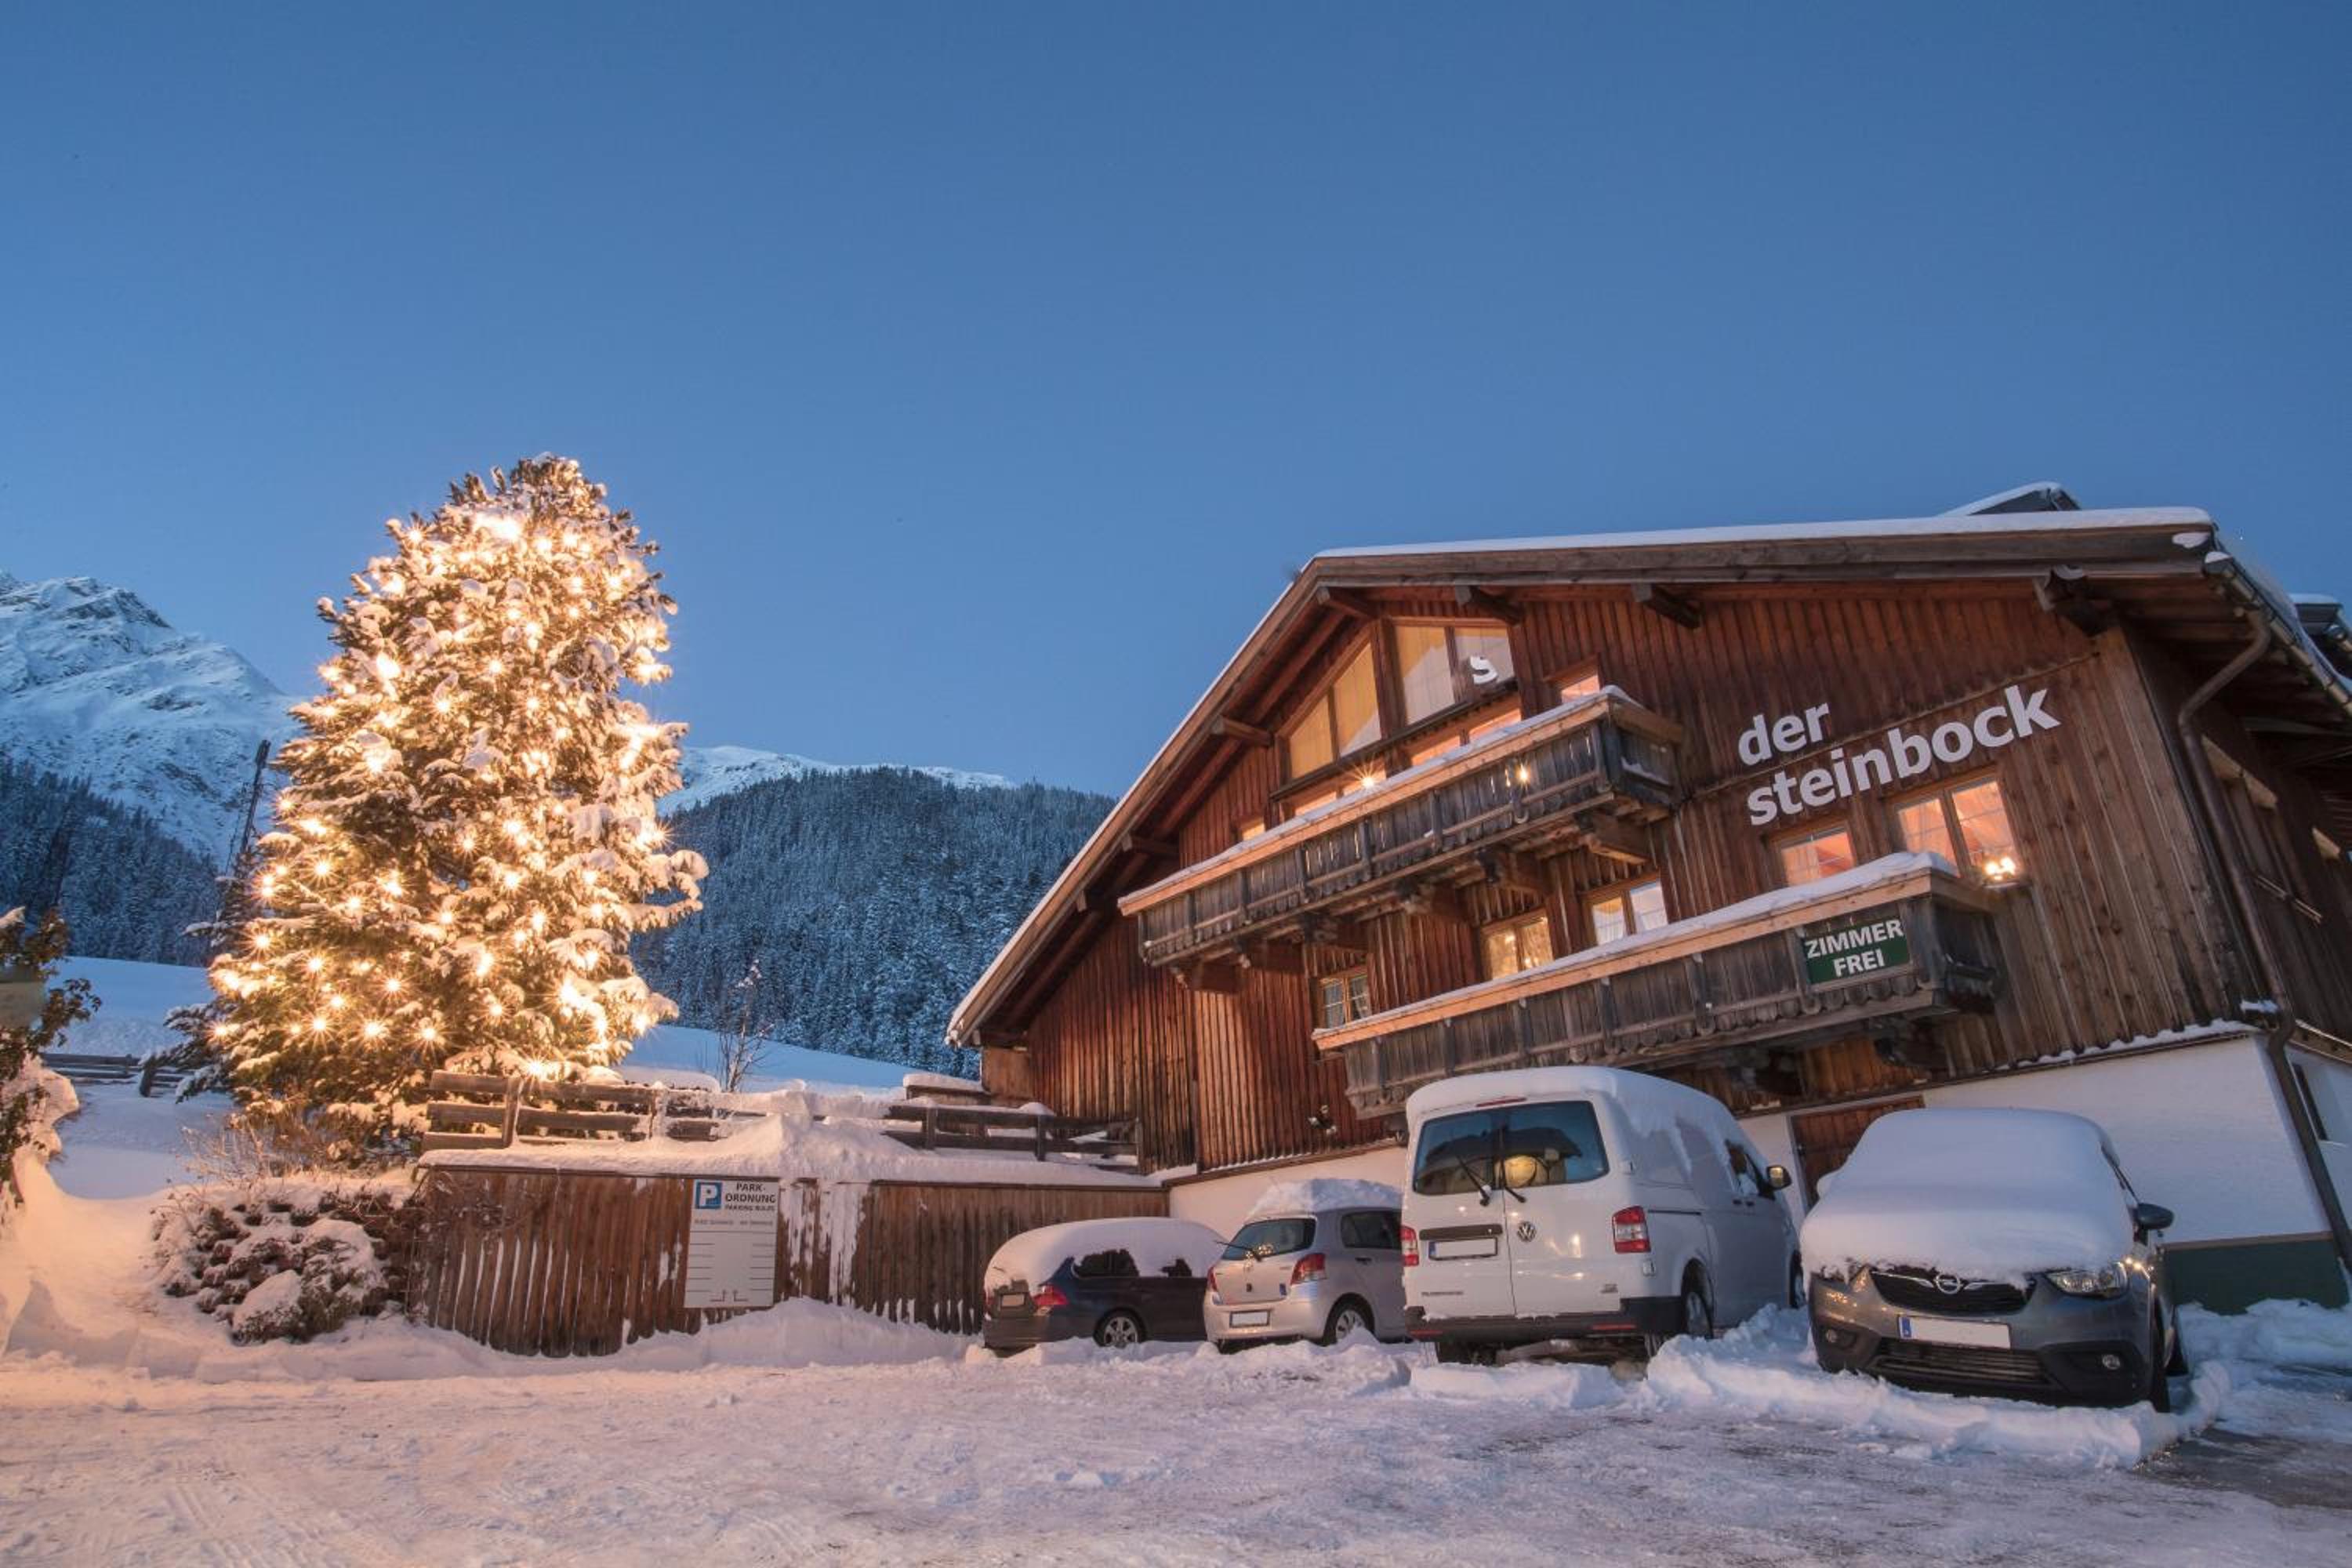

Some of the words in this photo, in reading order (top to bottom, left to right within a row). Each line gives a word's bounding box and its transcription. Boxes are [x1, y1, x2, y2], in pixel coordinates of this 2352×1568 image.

[1738, 702, 1830, 766] der
[1748, 684, 2061, 826] steinbock
[1805, 919, 1904, 959] ZIMMER
[1833, 948, 1886, 978] FREI
[725, 1193, 776, 1203] ORDNUNG
